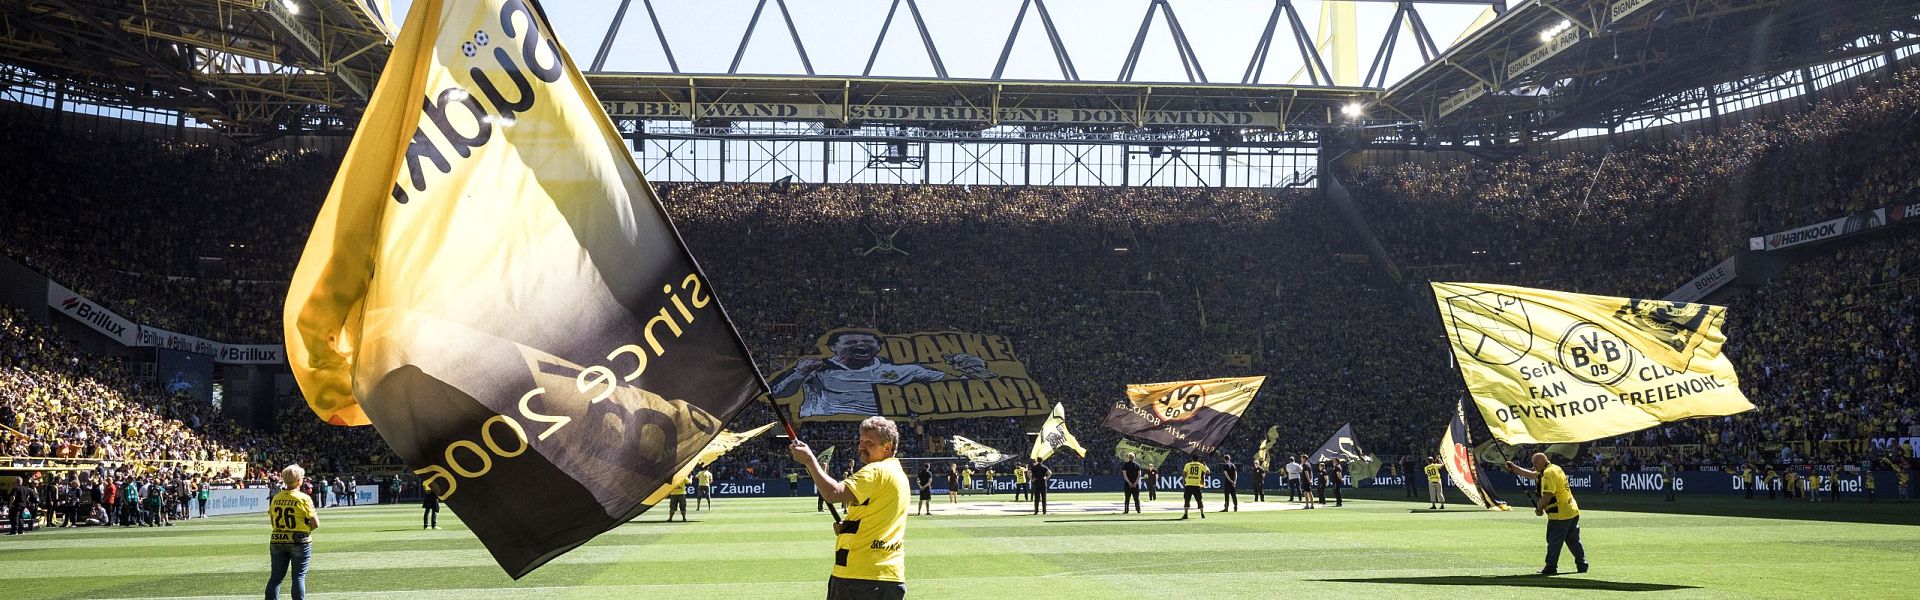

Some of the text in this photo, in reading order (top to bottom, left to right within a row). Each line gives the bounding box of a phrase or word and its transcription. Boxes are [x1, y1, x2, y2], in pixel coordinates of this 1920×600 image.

[1508, 30, 1578, 76] SIGNAL IDUNA PARK
[701, 103, 798, 117] WAND
[1071, 109, 1254, 125] DORTMUND
[76, 302, 126, 338] Brillux
[143, 329, 165, 347] Brillux
[229, 347, 276, 361] Brillux
[1570, 331, 1621, 369] BVB
[1519, 361, 1557, 381] Seit
[1590, 363, 1609, 377] 09
[877, 377, 1040, 416] ROMAN!
[1529, 380, 1568, 400] FAN
[719, 482, 766, 494] Zäune!
[1049, 478, 1092, 490] Zäune!
[222, 495, 238, 509] Guten
[240, 494, 259, 509] Morgen
[274, 506, 296, 529] 26
